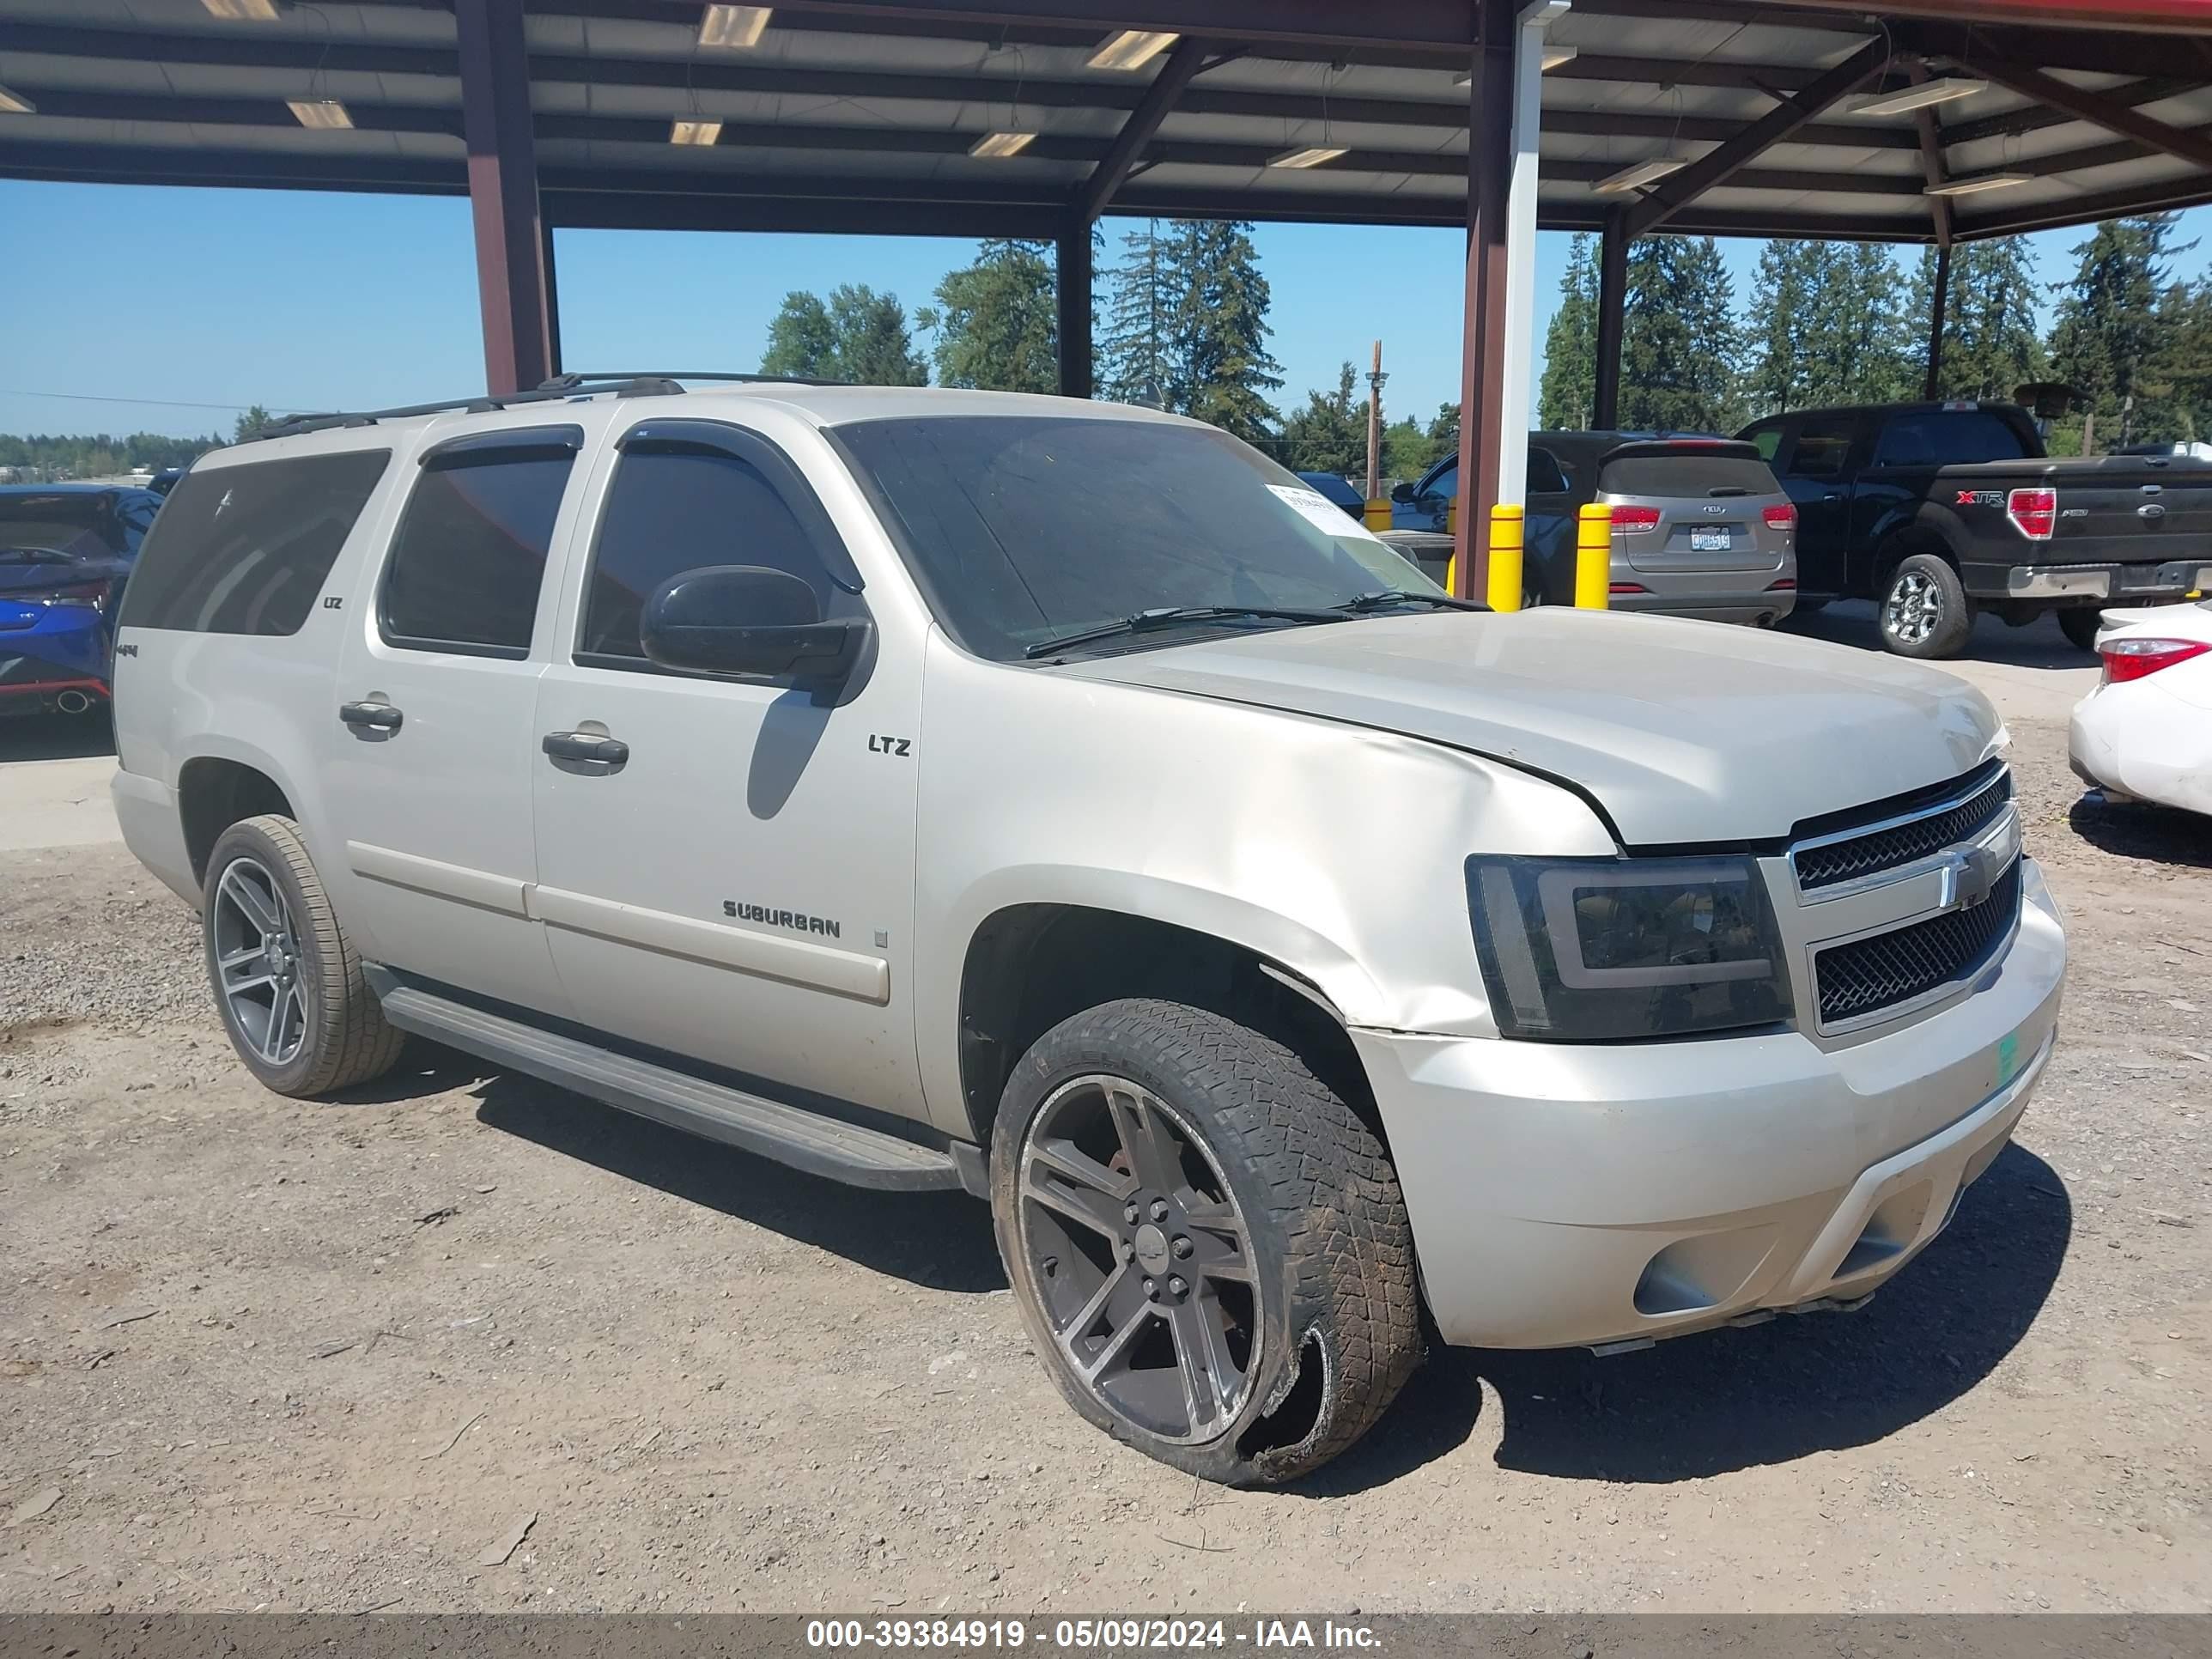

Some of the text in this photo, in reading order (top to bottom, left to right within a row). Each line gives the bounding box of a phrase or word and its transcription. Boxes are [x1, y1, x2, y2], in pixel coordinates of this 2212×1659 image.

[1956, 490, 2005, 504] XTR
[324, 597, 343, 610] LTZ
[868, 734, 911, 757] LTZ
[723, 900, 841, 939] SUBURBAN
